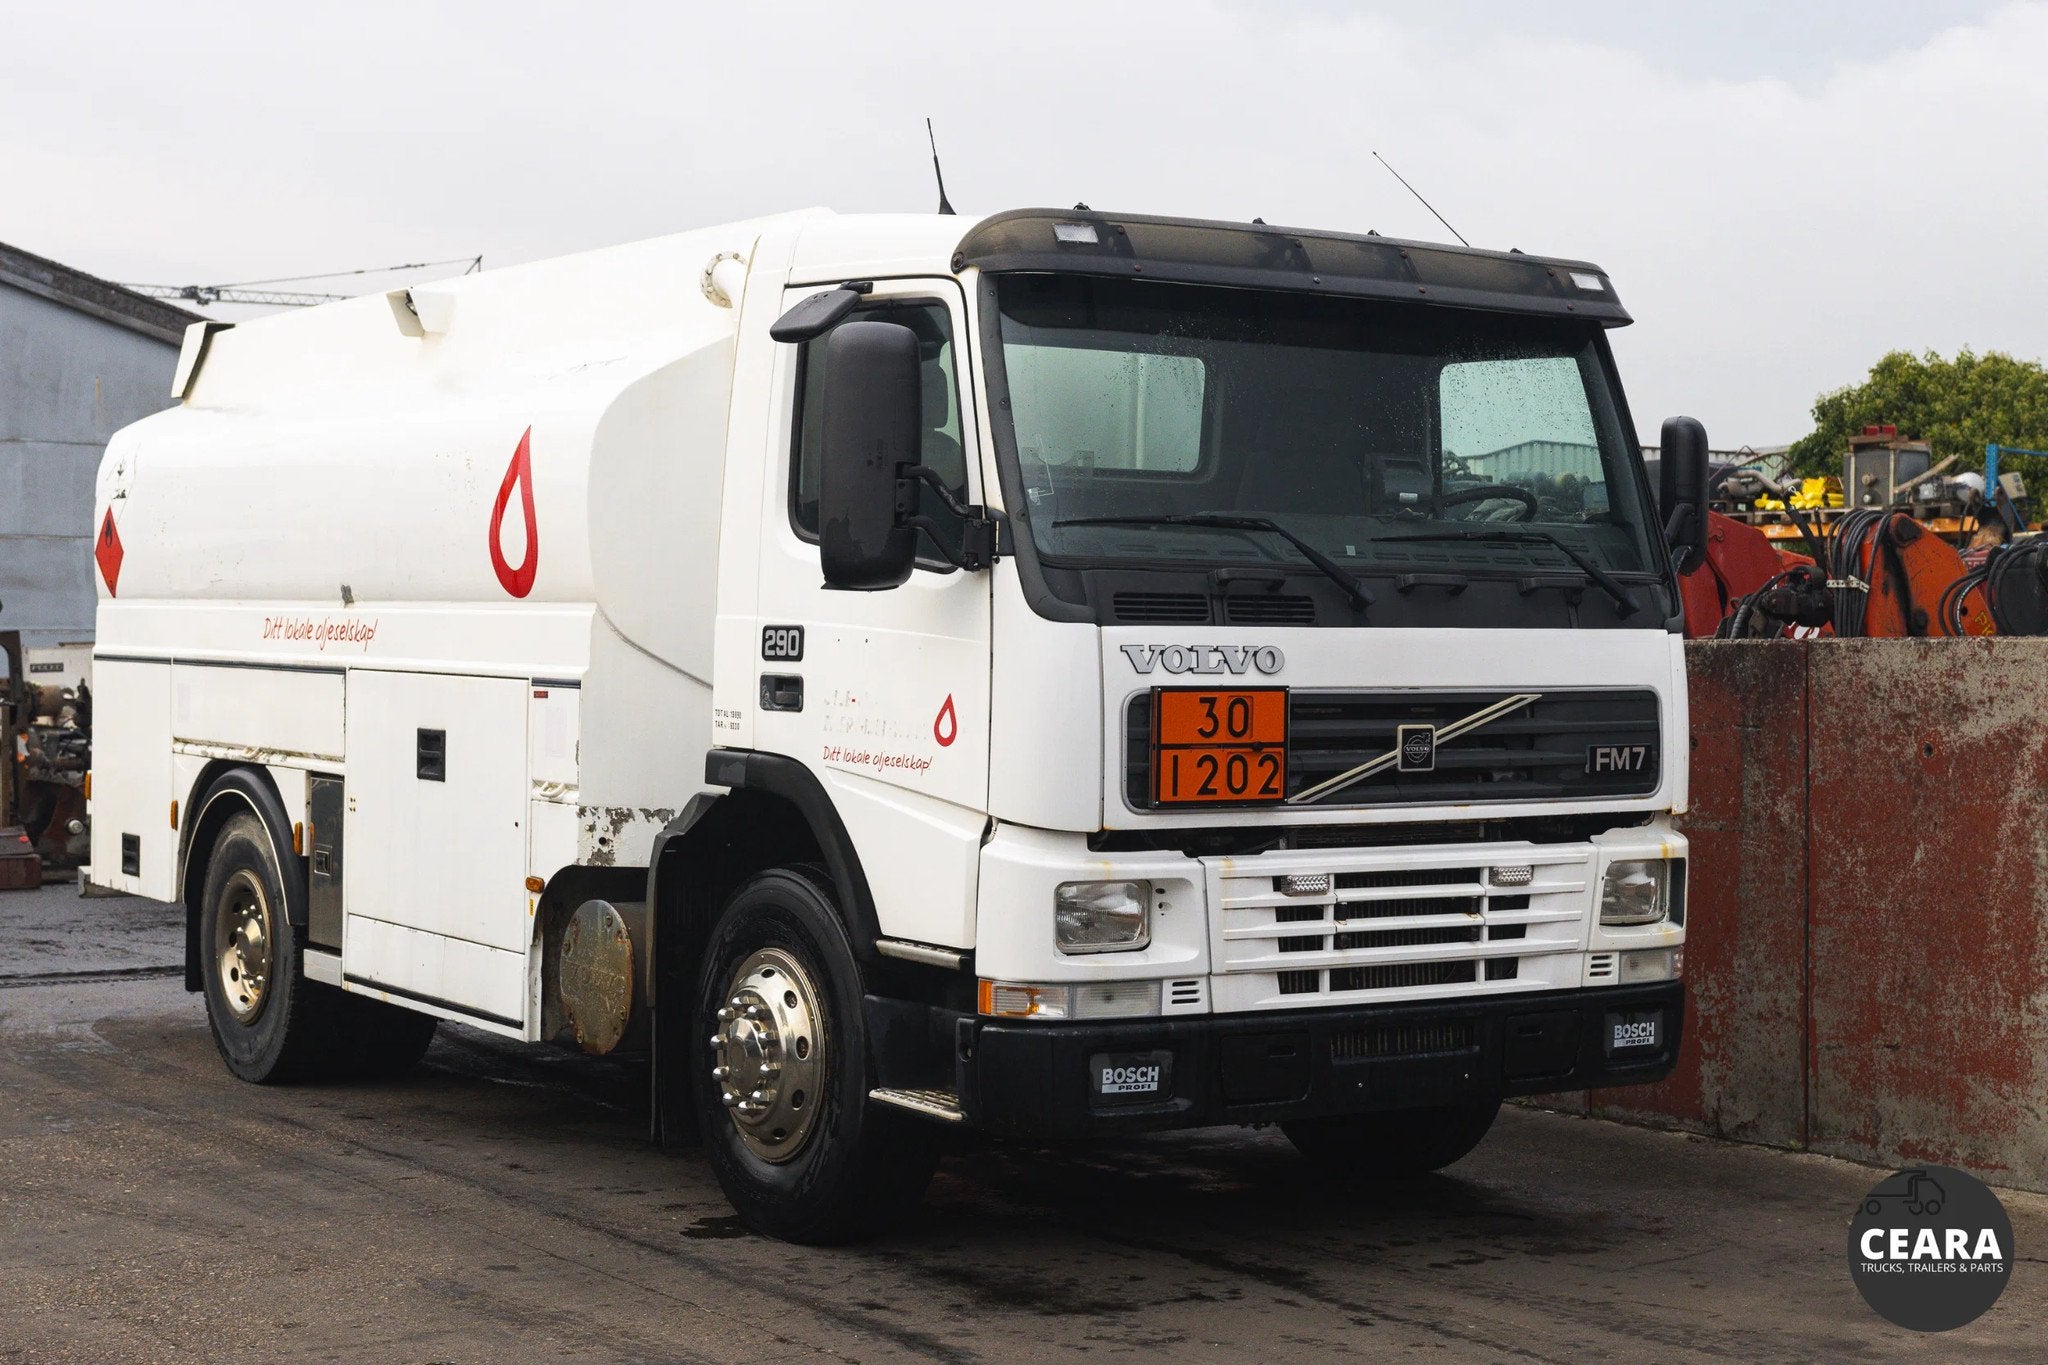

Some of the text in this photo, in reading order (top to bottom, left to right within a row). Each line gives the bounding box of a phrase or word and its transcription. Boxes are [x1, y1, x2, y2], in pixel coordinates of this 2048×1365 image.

[263, 617, 282, 639] Ditt
[284, 617, 313, 640] lokale
[764, 629, 800, 657] 290
[1120, 644, 1286, 675] VOLVO
[1197, 696, 1250, 739] 30
[822, 745, 842, 761] Ditt
[843, 748, 871, 765] lokale
[1596, 746, 1646, 772] FM7
[1171, 753, 1281, 797] 1202
[1614, 1021, 1655, 1039] BOSCH
[1102, 1066, 1159, 1084] BOSCH
[1118, 1083, 1151, 1091] PROFI
